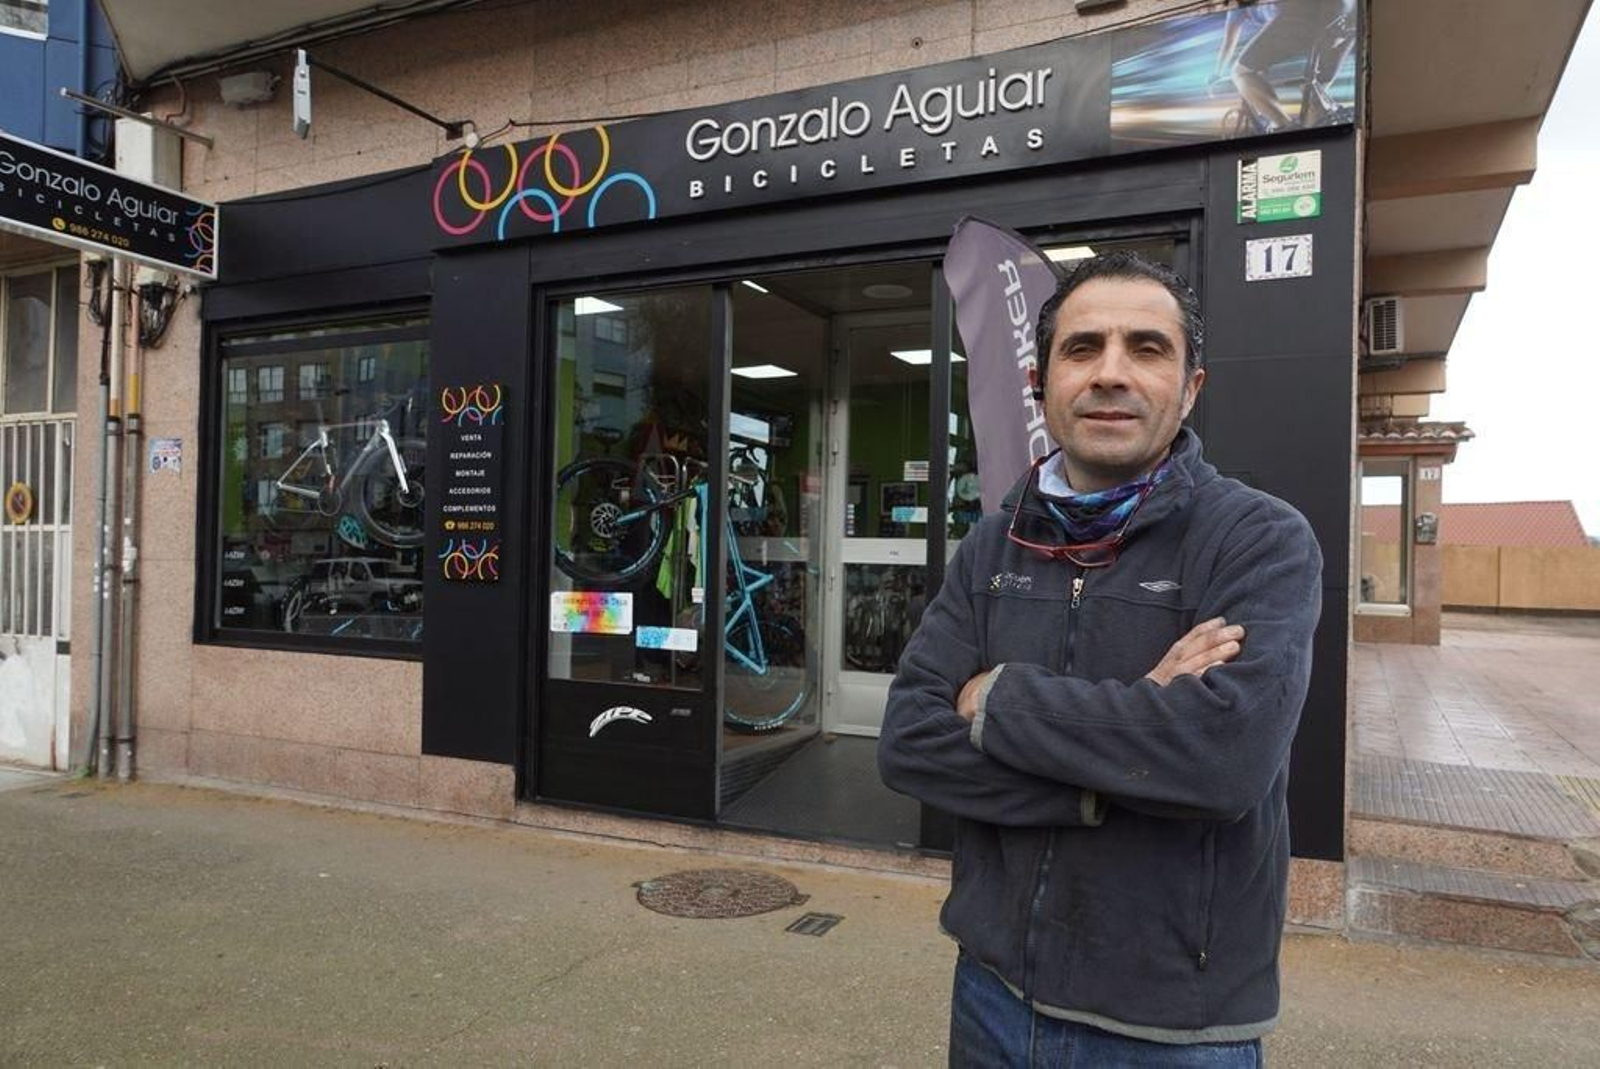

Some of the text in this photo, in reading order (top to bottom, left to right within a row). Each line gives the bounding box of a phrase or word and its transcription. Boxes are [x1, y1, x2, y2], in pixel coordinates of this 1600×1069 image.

[685, 68, 1053, 162] Gonzalo Aguiar
[689, 129, 1045, 198] BICICLETAS
[0, 151, 179, 226] Gonzalo Aguiar
[1241, 161, 1257, 218] ALARMA
[1264, 244, 1300, 272] 17
[450, 450, 492, 459] REPARACIÓN
[455, 469, 485, 477] MONTAJE
[449, 487, 491, 495] ACCESORIOS
[443, 505, 496, 513] COMPLEMENTOS
